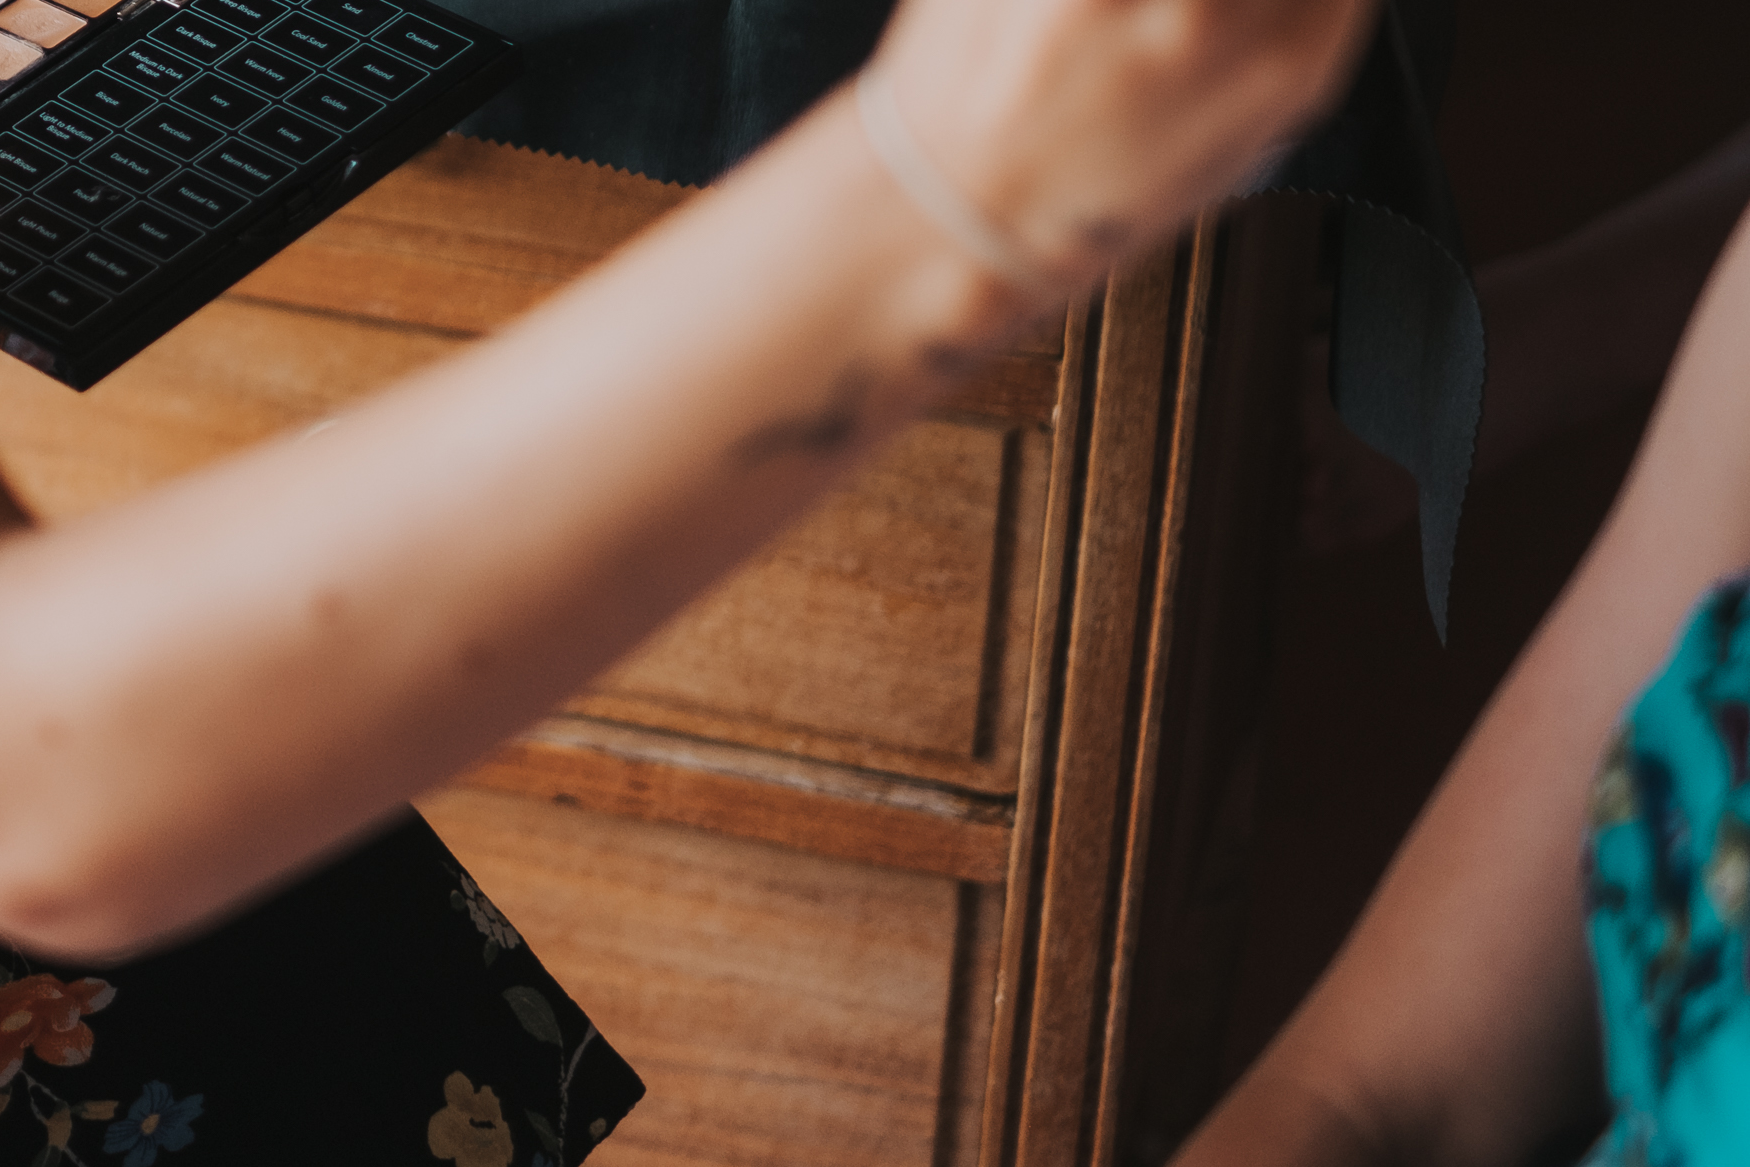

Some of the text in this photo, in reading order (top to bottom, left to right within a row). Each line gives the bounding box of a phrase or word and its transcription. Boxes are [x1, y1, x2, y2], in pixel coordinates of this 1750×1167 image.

[236, 3, 261, 19] Bisque
[341, 2, 363, 15] Sand
[175, 26, 217, 49] Dark Bisque
[291, 29, 328, 50] Cool Sand
[405, 32, 439, 51] Chestnut
[128, 50, 185, 80] Medium to Dark
[136, 62, 161, 79] Bisque
[244, 58, 286, 82] Warm Ivory
[363, 63, 395, 81] Almond
[95, 91, 120, 107] Bisque
[210, 94, 230, 108] Ivory
[321, 95, 348, 112] Golden
[39, 111, 94, 142] Light to Medium
[46, 124, 71, 141] Bisque
[158, 122, 192, 142] Porcelain
[276, 127, 302, 143] Honey
[12, 157, 38, 174] Bisque
[110, 152, 150, 176] Dark Peach
[220, 152, 272, 181] Warm Natural
[73, 188, 96, 203] Peach
[178, 186, 220, 211] Natural Tan
[17, 216, 58, 240] Light Peach
[138, 222, 169, 240] Natural
[85, 251, 128, 277] Warm Beige
